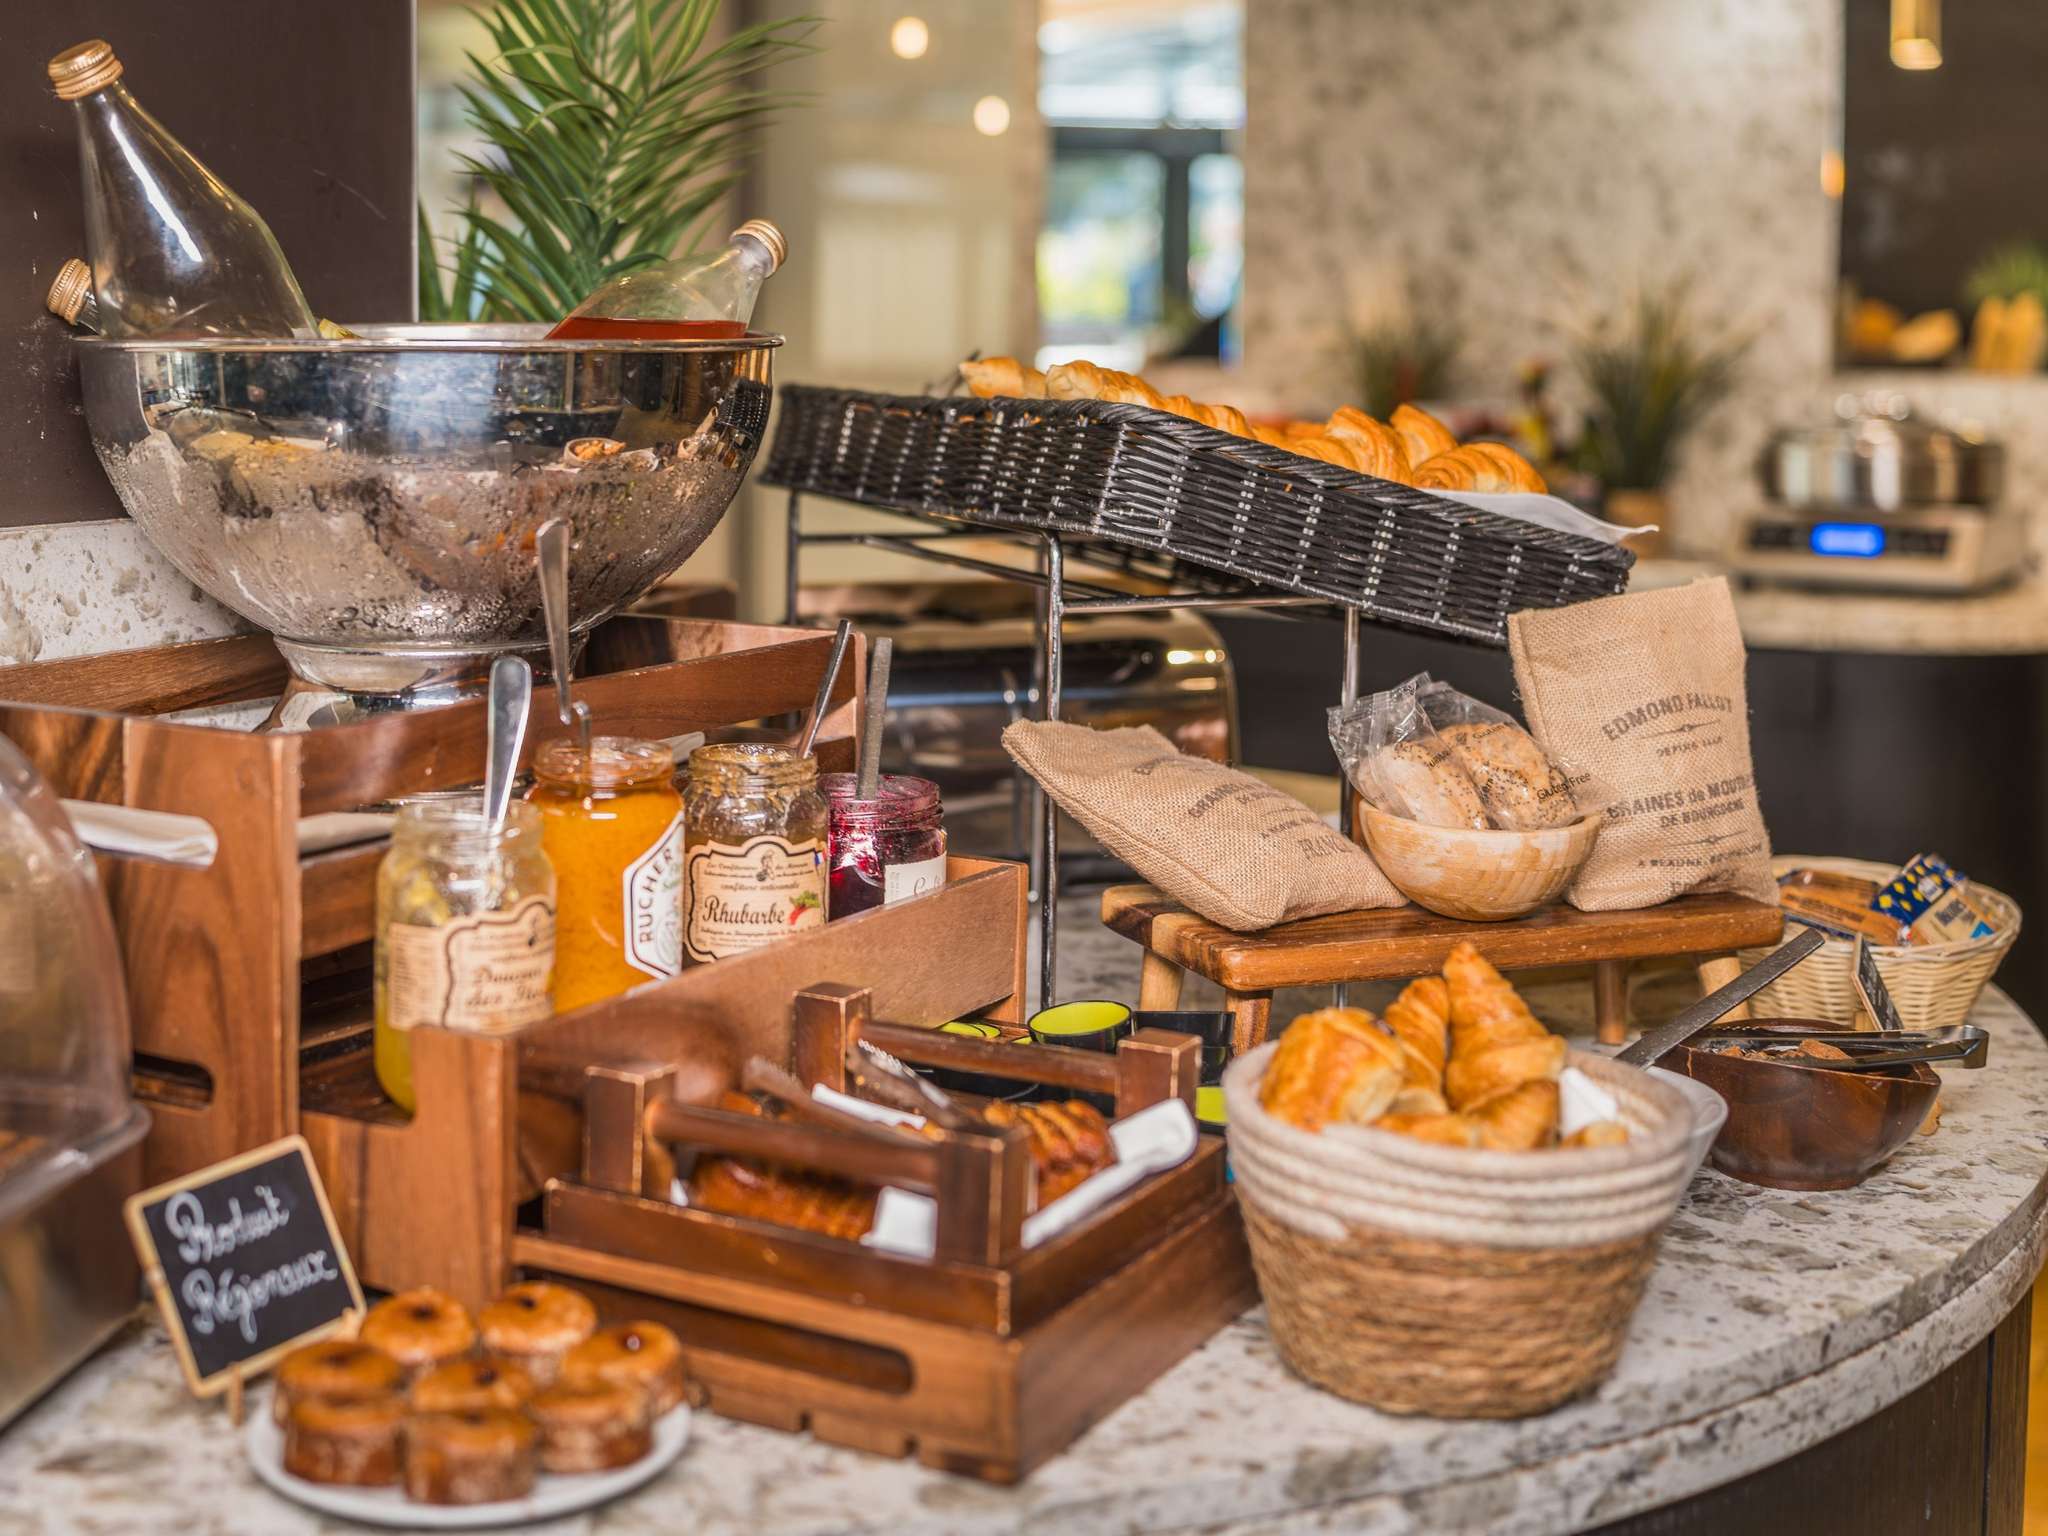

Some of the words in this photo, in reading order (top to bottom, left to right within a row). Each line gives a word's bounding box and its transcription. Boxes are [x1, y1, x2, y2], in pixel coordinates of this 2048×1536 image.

[1602, 694, 1684, 742] EDMOND
[1686, 692, 1732, 713] FALLOT
[1536, 782, 1569, 800] Gluten
[1568, 772, 1591, 788] Free
[639, 848, 673, 944] RUCHER
[702, 895, 785, 925] Rhubarbe
